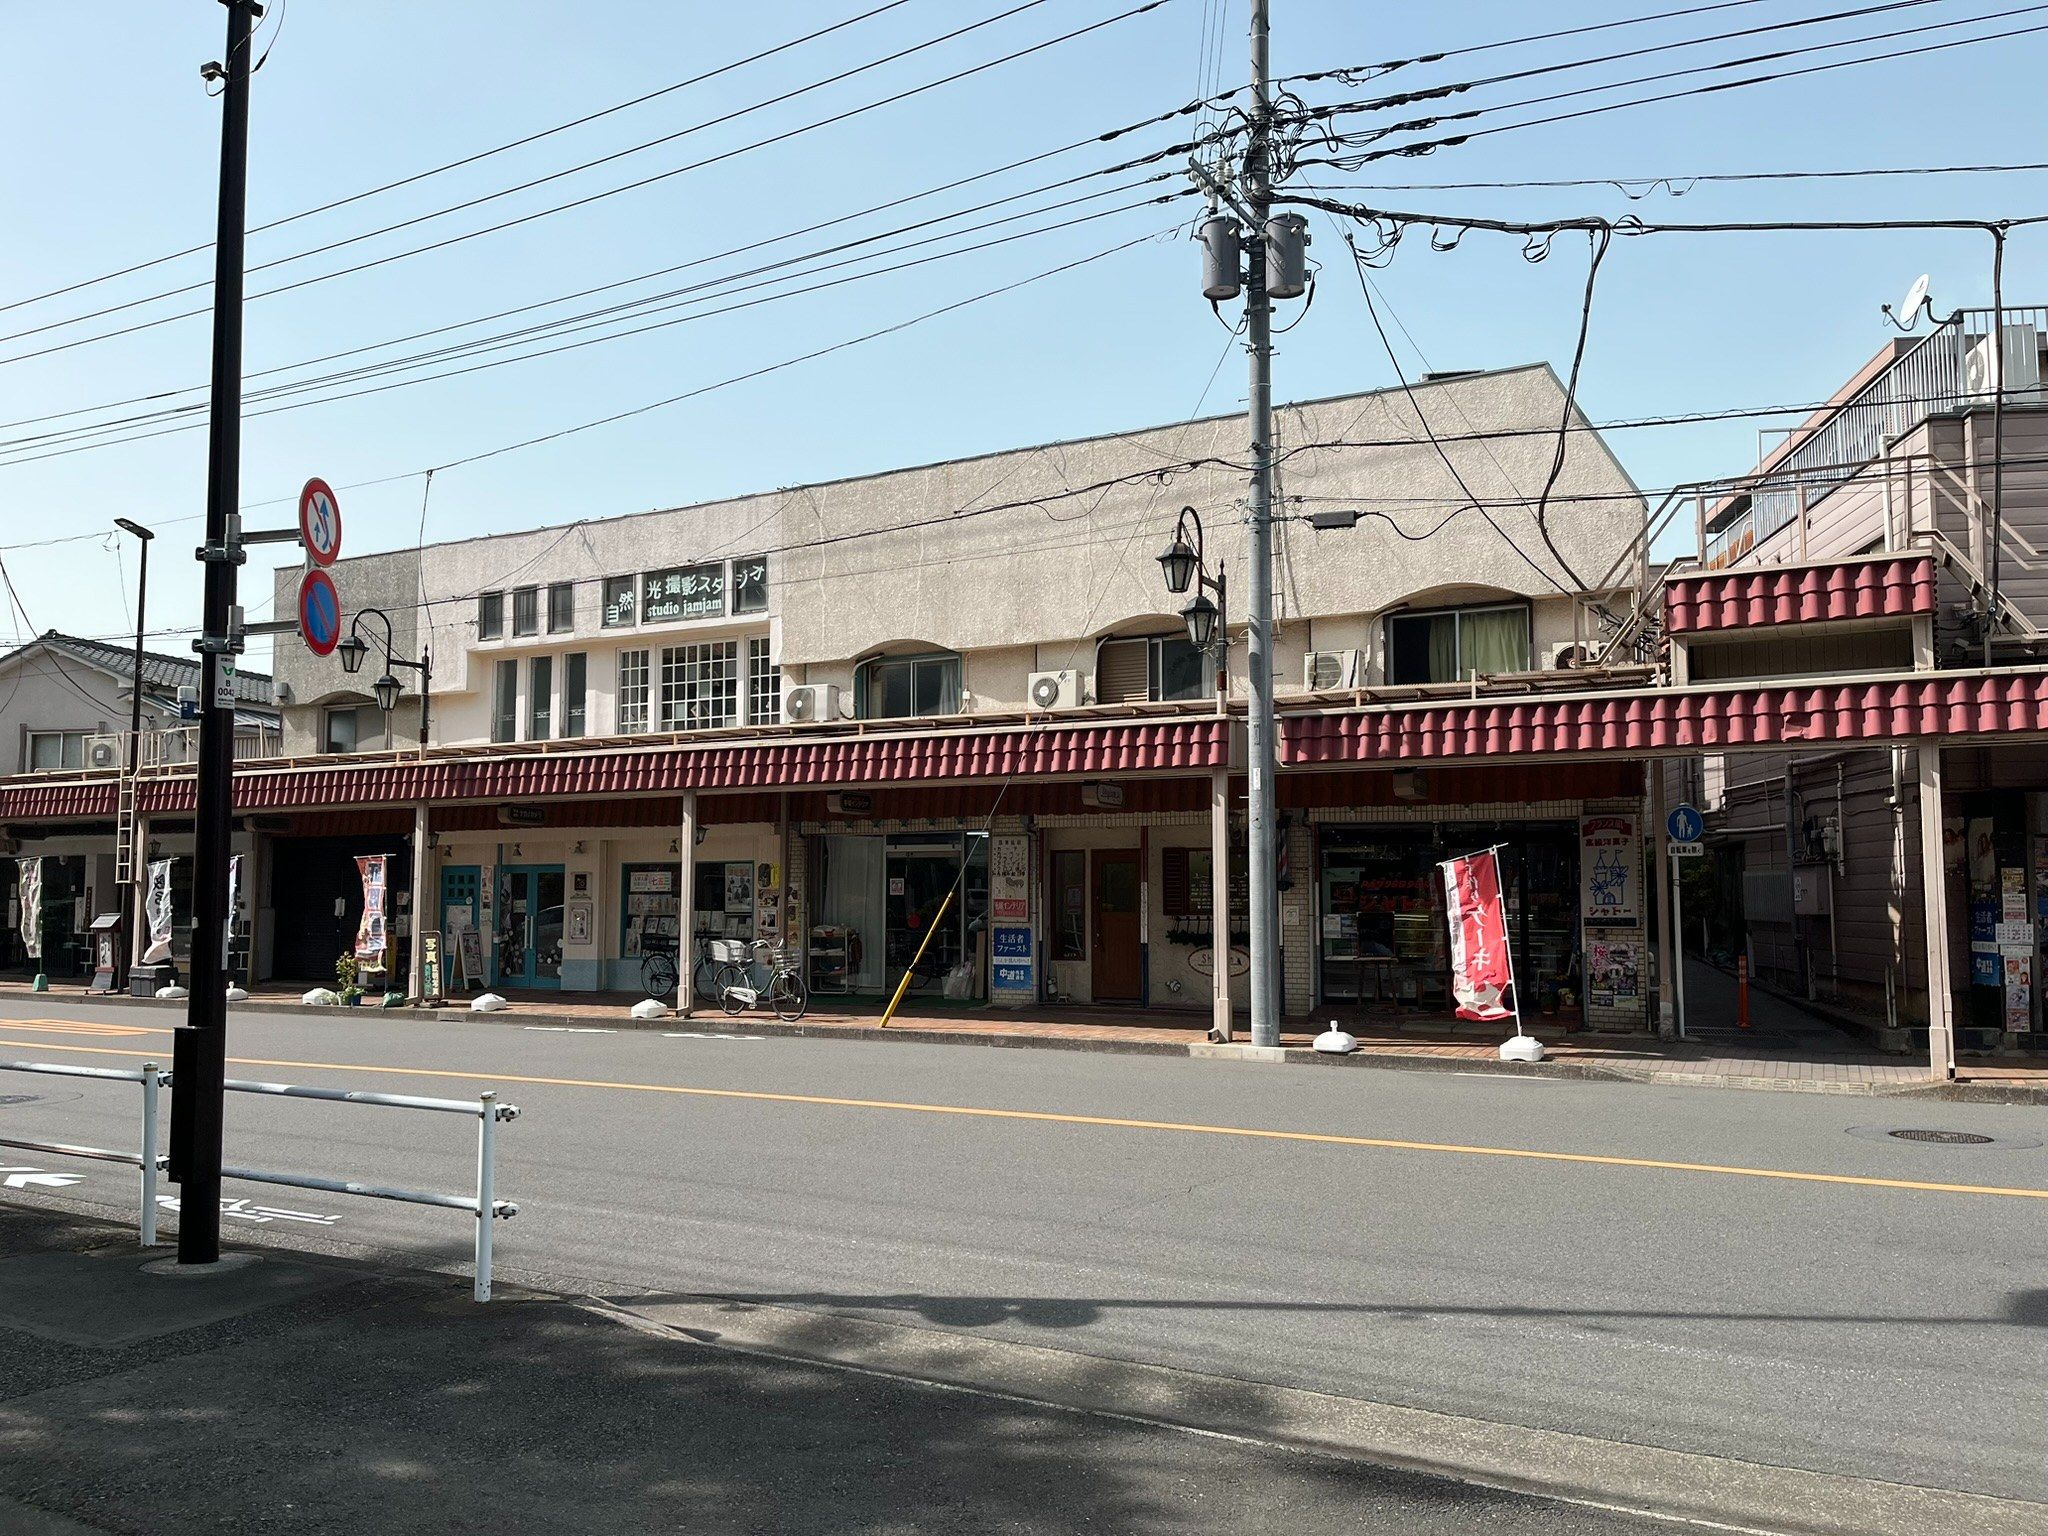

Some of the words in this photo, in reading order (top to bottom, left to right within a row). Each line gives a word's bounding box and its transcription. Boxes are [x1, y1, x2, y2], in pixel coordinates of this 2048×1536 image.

[606, 565, 764, 623] 自然光撮影スタジオ
[647, 602, 680, 618] studio
[683, 598, 722, 616] jamjam
[225, 679, 231, 687] B
[1670, 846, 1701, 854] 自転車を除く
[1590, 907, 1632, 916] シャトー
[999, 934, 1025, 944] 生活者
[425, 938, 437, 964] 写真
[997, 945, 1028, 953] ファースト
